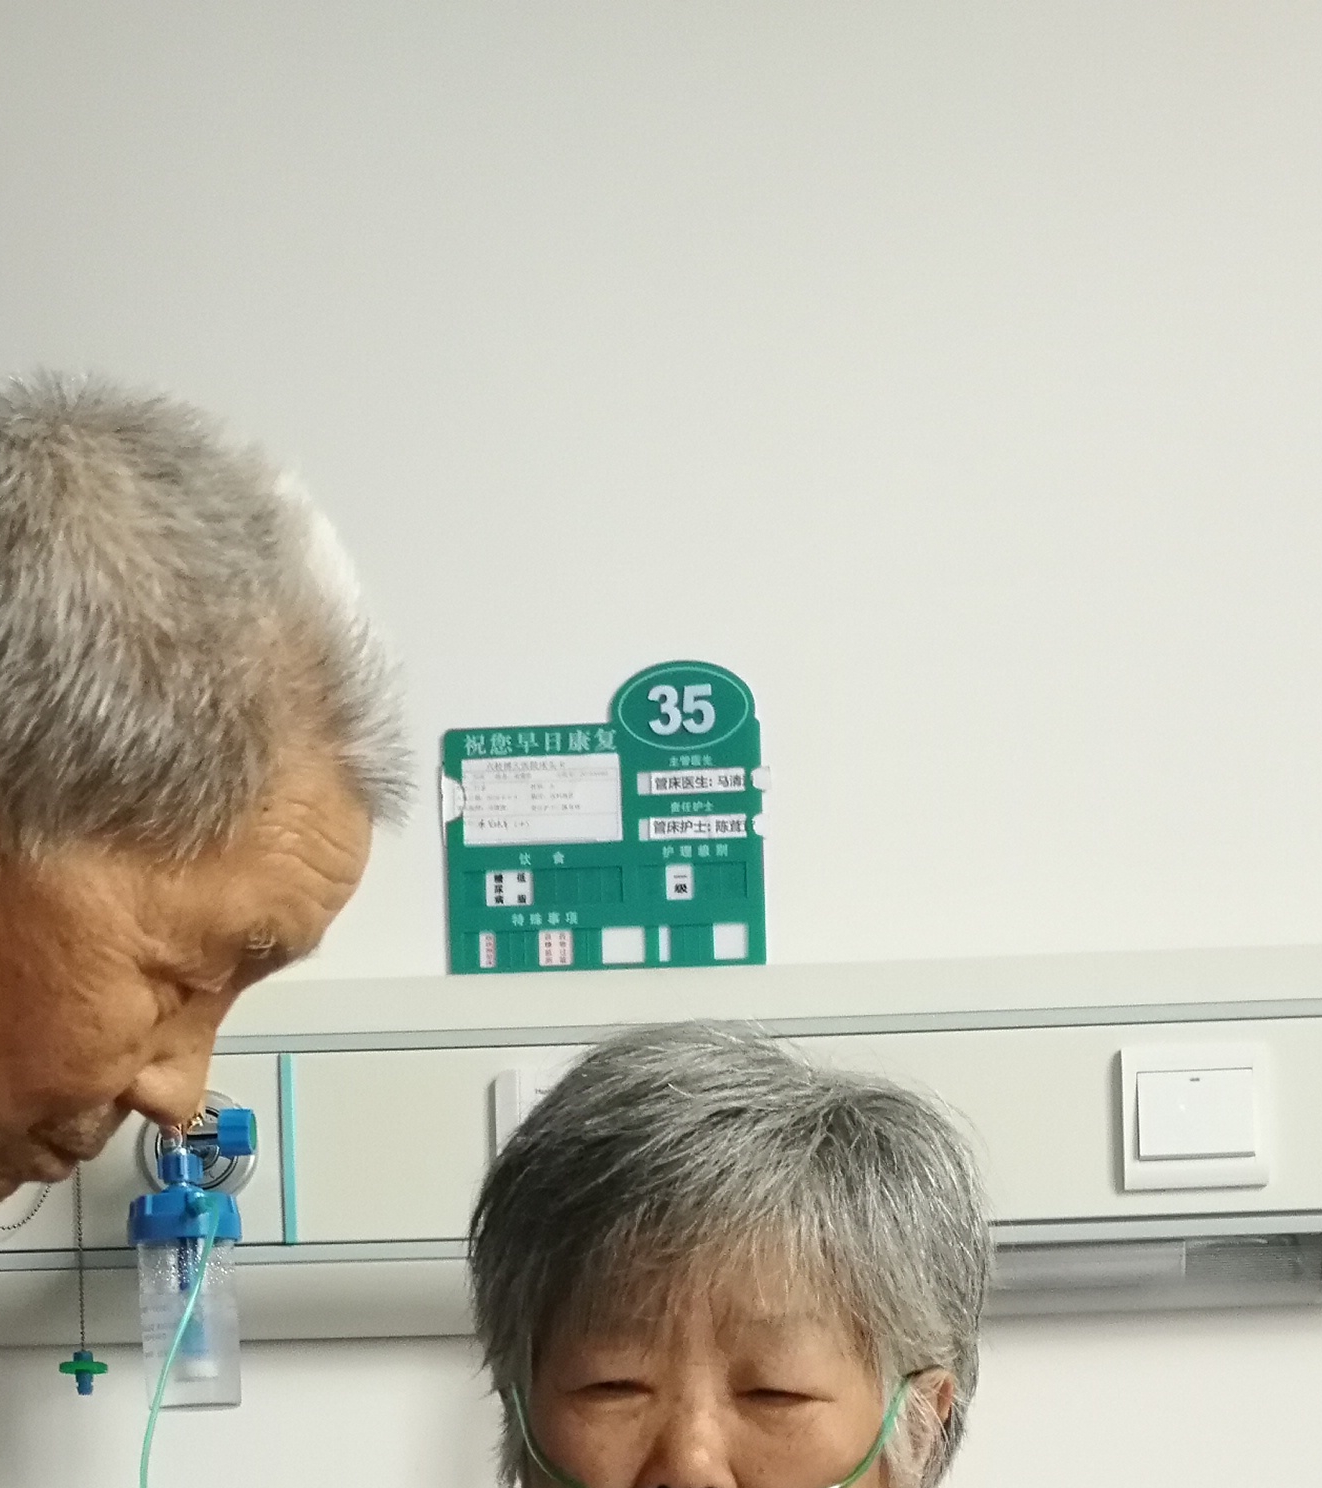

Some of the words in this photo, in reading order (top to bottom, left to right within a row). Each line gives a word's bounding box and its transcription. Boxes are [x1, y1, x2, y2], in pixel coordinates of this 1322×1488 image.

[648, 683, 716, 736] 35
[463, 727, 617, 756] 祝您早日康复
[670, 800, 714, 813] 责任护士
[518, 851, 565, 866] 饮食
[662, 843, 729, 859] 护理级别
[493, 873, 504, 905] 糖尿病
